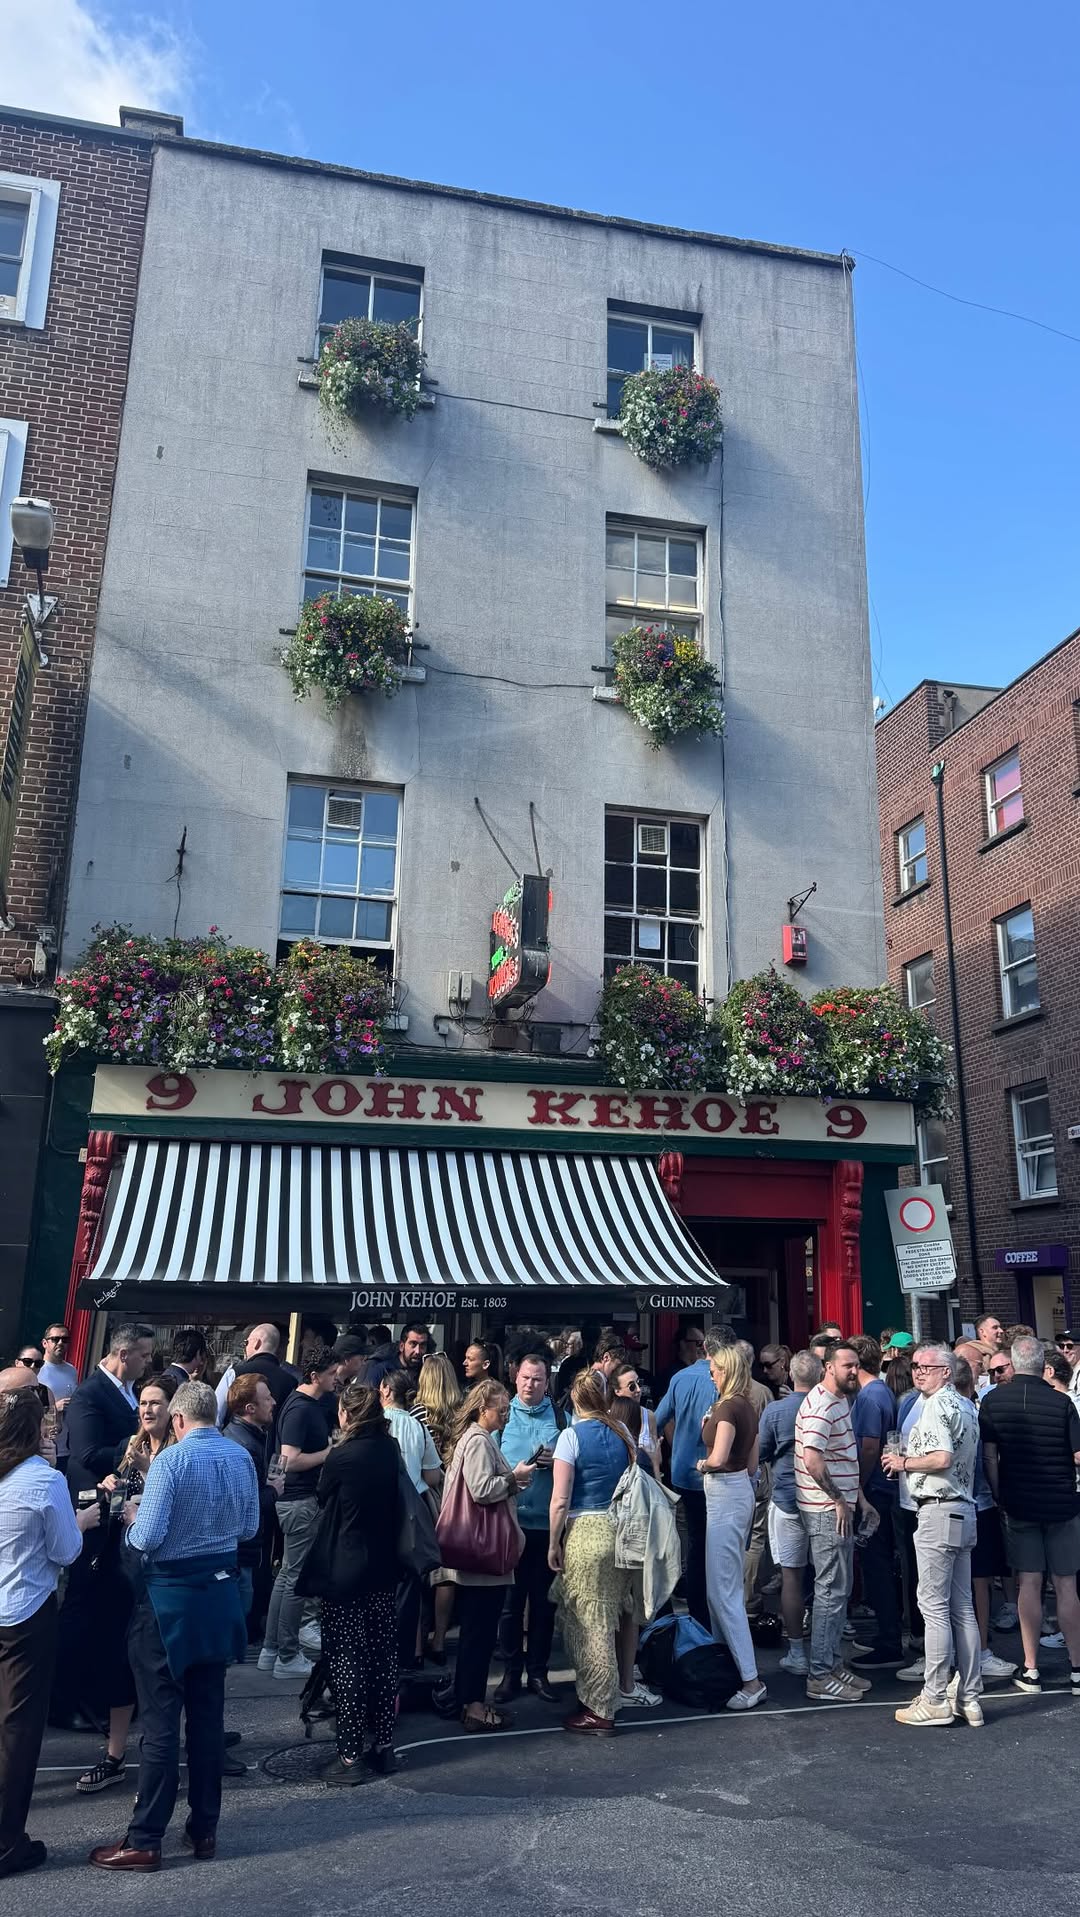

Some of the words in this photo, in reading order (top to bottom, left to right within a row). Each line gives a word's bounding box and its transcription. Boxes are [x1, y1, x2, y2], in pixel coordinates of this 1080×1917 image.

[146, 1073, 198, 1110] 9
[252, 1079, 484, 1122] JOHN
[527, 1089, 781, 1135] KEHOE
[825, 1105, 868, 1139] 9
[1005, 1251, 1038, 1263] COFFEE
[350, 1292, 395, 1311] JOHN
[399, 1292, 457, 1308] KEHOE
[461, 1297, 479, 1308] Est.
[483, 1297, 507, 1308] 1803
[649, 1294, 716, 1308] GUINNESS
